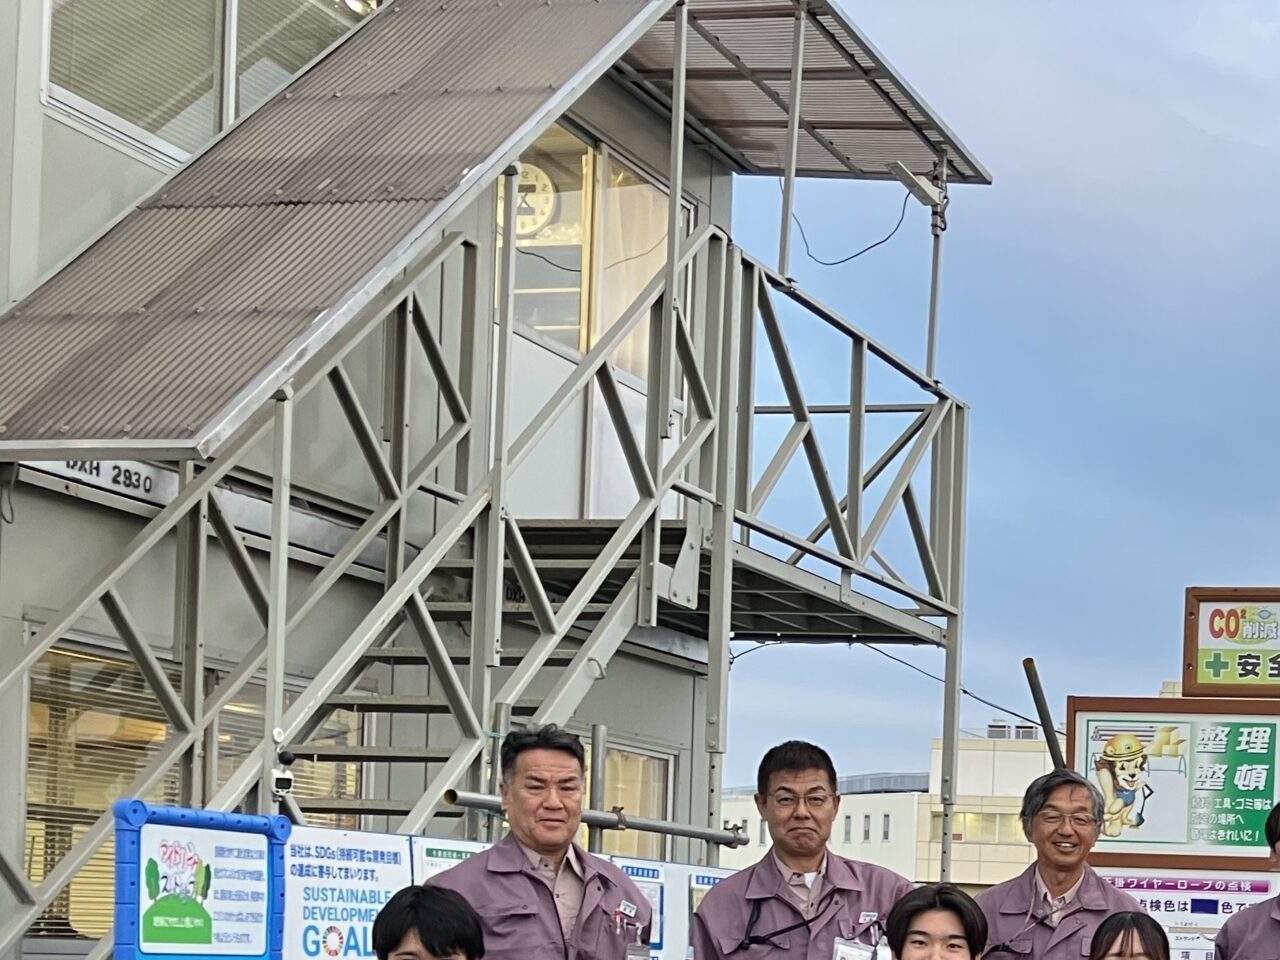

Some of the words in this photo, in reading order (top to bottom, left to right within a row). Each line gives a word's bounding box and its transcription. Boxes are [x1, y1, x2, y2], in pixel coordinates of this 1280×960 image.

[1196, 726, 1271, 754] 整理
[1193, 764, 1269, 791] 整頓
[1181, 951, 1214, 960] 項目
